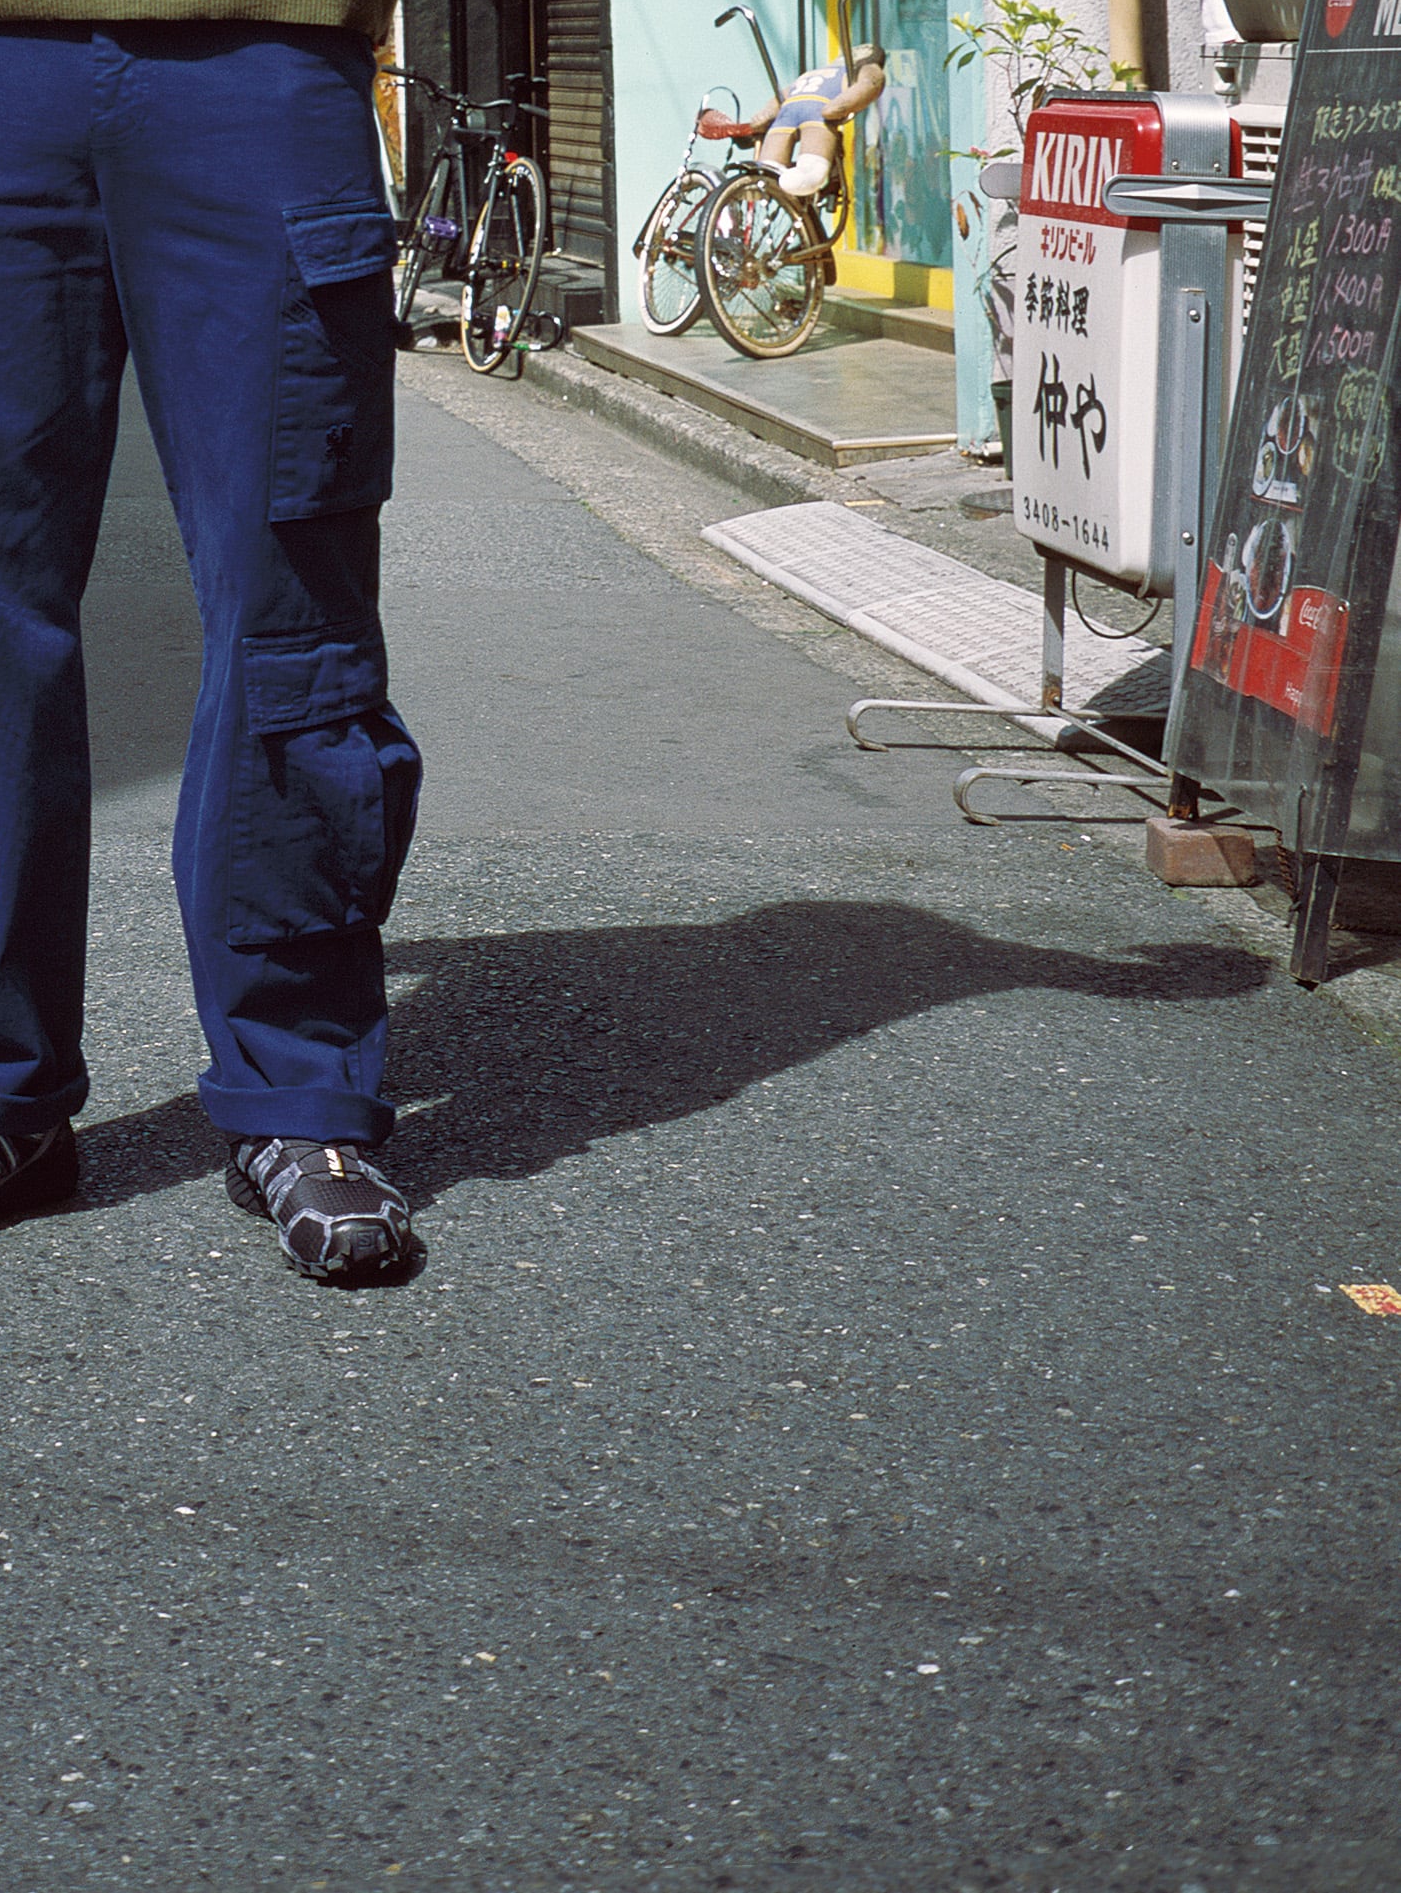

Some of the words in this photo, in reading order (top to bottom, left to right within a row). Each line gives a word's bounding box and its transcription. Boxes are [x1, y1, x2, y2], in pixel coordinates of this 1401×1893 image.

[1030, 131, 1124, 208] KIRIN
[1040, 224, 1097, 266] キリンビール
[1024, 272, 1091, 339] 季節料理
[1032, 350, 1107, 481] 仲や
[1023, 495, 1110, 554] 3408-1644
